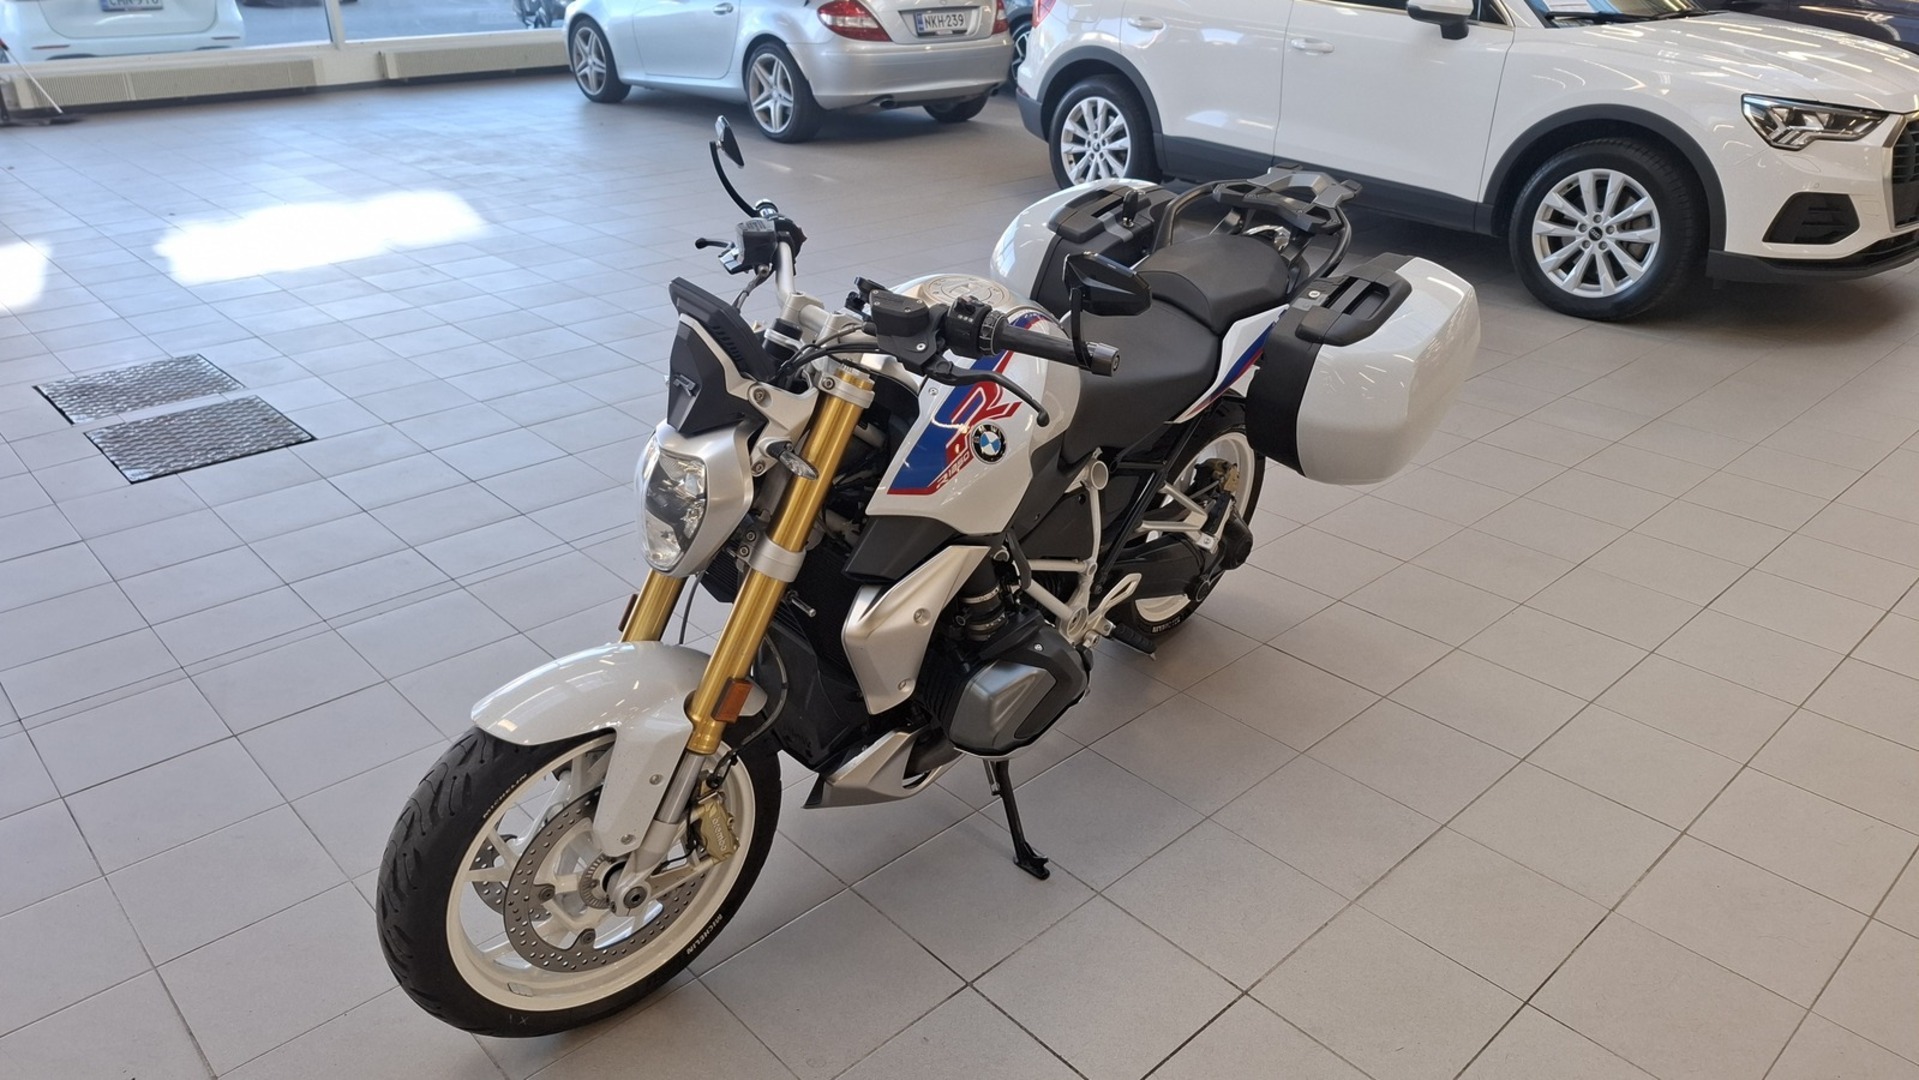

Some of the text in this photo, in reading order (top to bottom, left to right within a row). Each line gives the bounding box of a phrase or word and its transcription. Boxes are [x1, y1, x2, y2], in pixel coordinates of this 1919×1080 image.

[924, 14, 964, 28] NKH-239
[483, 773, 527, 819] MICHELIN
[686, 913, 723, 955] MICHELIN
